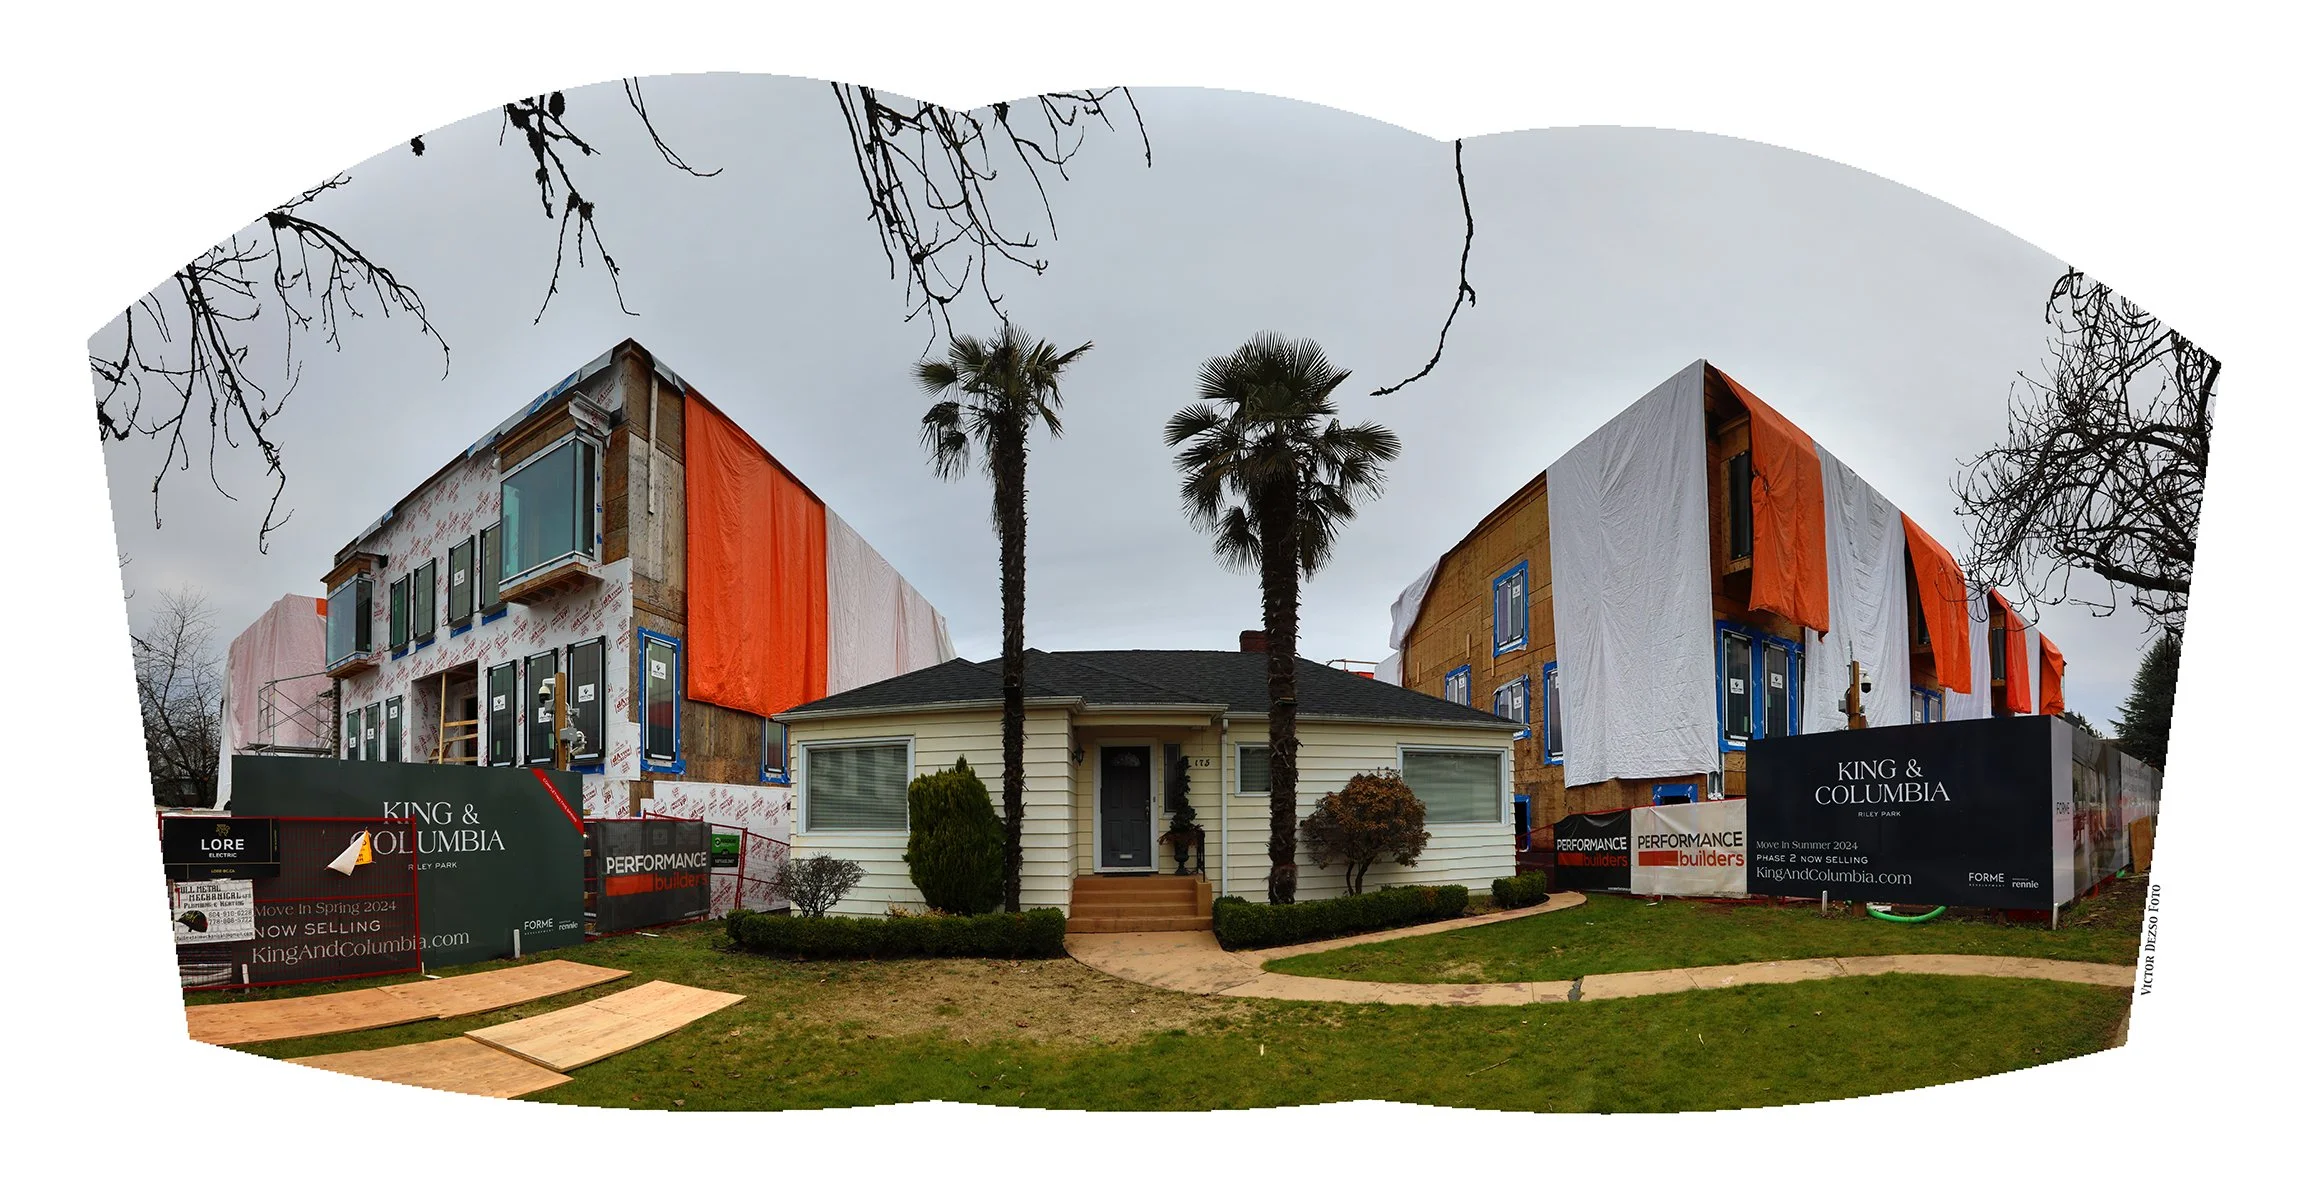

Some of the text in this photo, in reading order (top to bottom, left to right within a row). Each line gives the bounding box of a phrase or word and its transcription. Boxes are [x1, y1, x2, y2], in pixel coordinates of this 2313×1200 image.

[1838, 758, 1923, 781] KING &
[1815, 782, 1950, 805] COLUMBIA
[383, 802, 480, 825] KING &
[201, 838, 244, 850] LORE
[1556, 836, 1627, 851] PERFORMANCE
[1638, 831, 1743, 849] PERFORMANCE
[1756, 841, 1858, 850] Move In Summer 2024
[606, 851, 707, 874] PERFORMANCE
[1584, 854, 1628, 866] builders
[1680, 850, 1744, 866] builders
[1789, 854, 1796, 862] 2
[1826, 856, 1868, 864] SELLING
[655, 871, 708, 892] builders
[1756, 867, 1912, 885] KingAndColumbia.com
[1968, 872, 2004, 882] FORME
[189, 892, 241, 901] MECHANICAL
[254, 900, 397, 916] Move In Spring 2024
[254, 920, 381, 939] NOW SELLING
[524, 918, 578, 930] FORME rennie
[252, 931, 470, 965] KingAndColumbia.com
